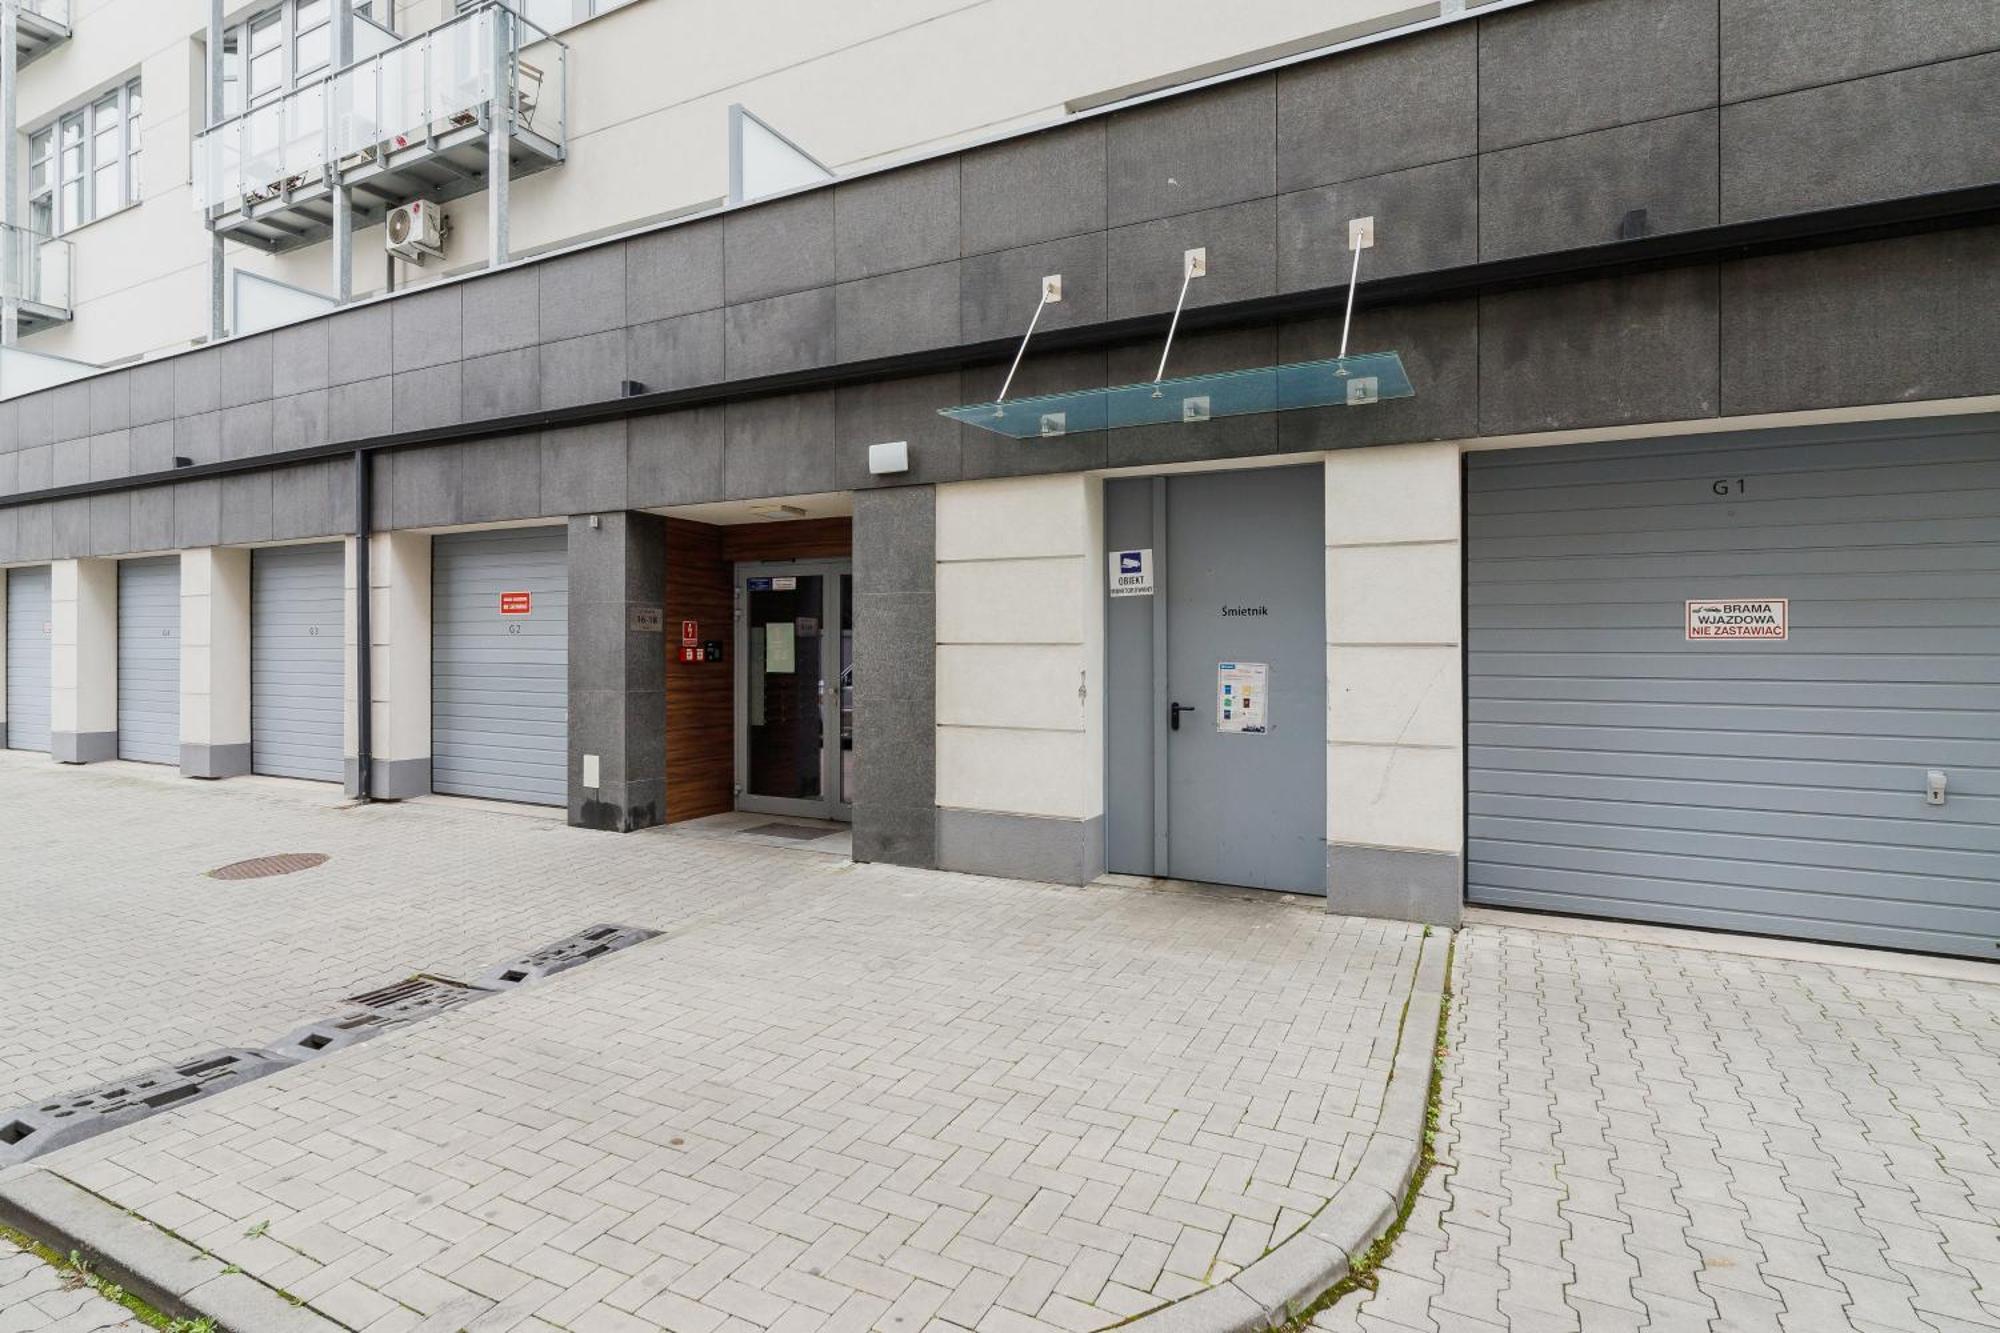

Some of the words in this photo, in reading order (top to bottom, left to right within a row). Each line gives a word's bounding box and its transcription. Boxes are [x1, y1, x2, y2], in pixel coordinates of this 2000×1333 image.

[1118, 576, 1145, 586] OBIEKT
[1222, 604, 1269, 617] Śmietnik
[1723, 604, 1772, 614] BRAMA
[1698, 615, 1776, 625] WJAZDOWA
[1692, 626, 1711, 636] NIE
[1714, 624, 1782, 636] ZASTAWIAĆ
